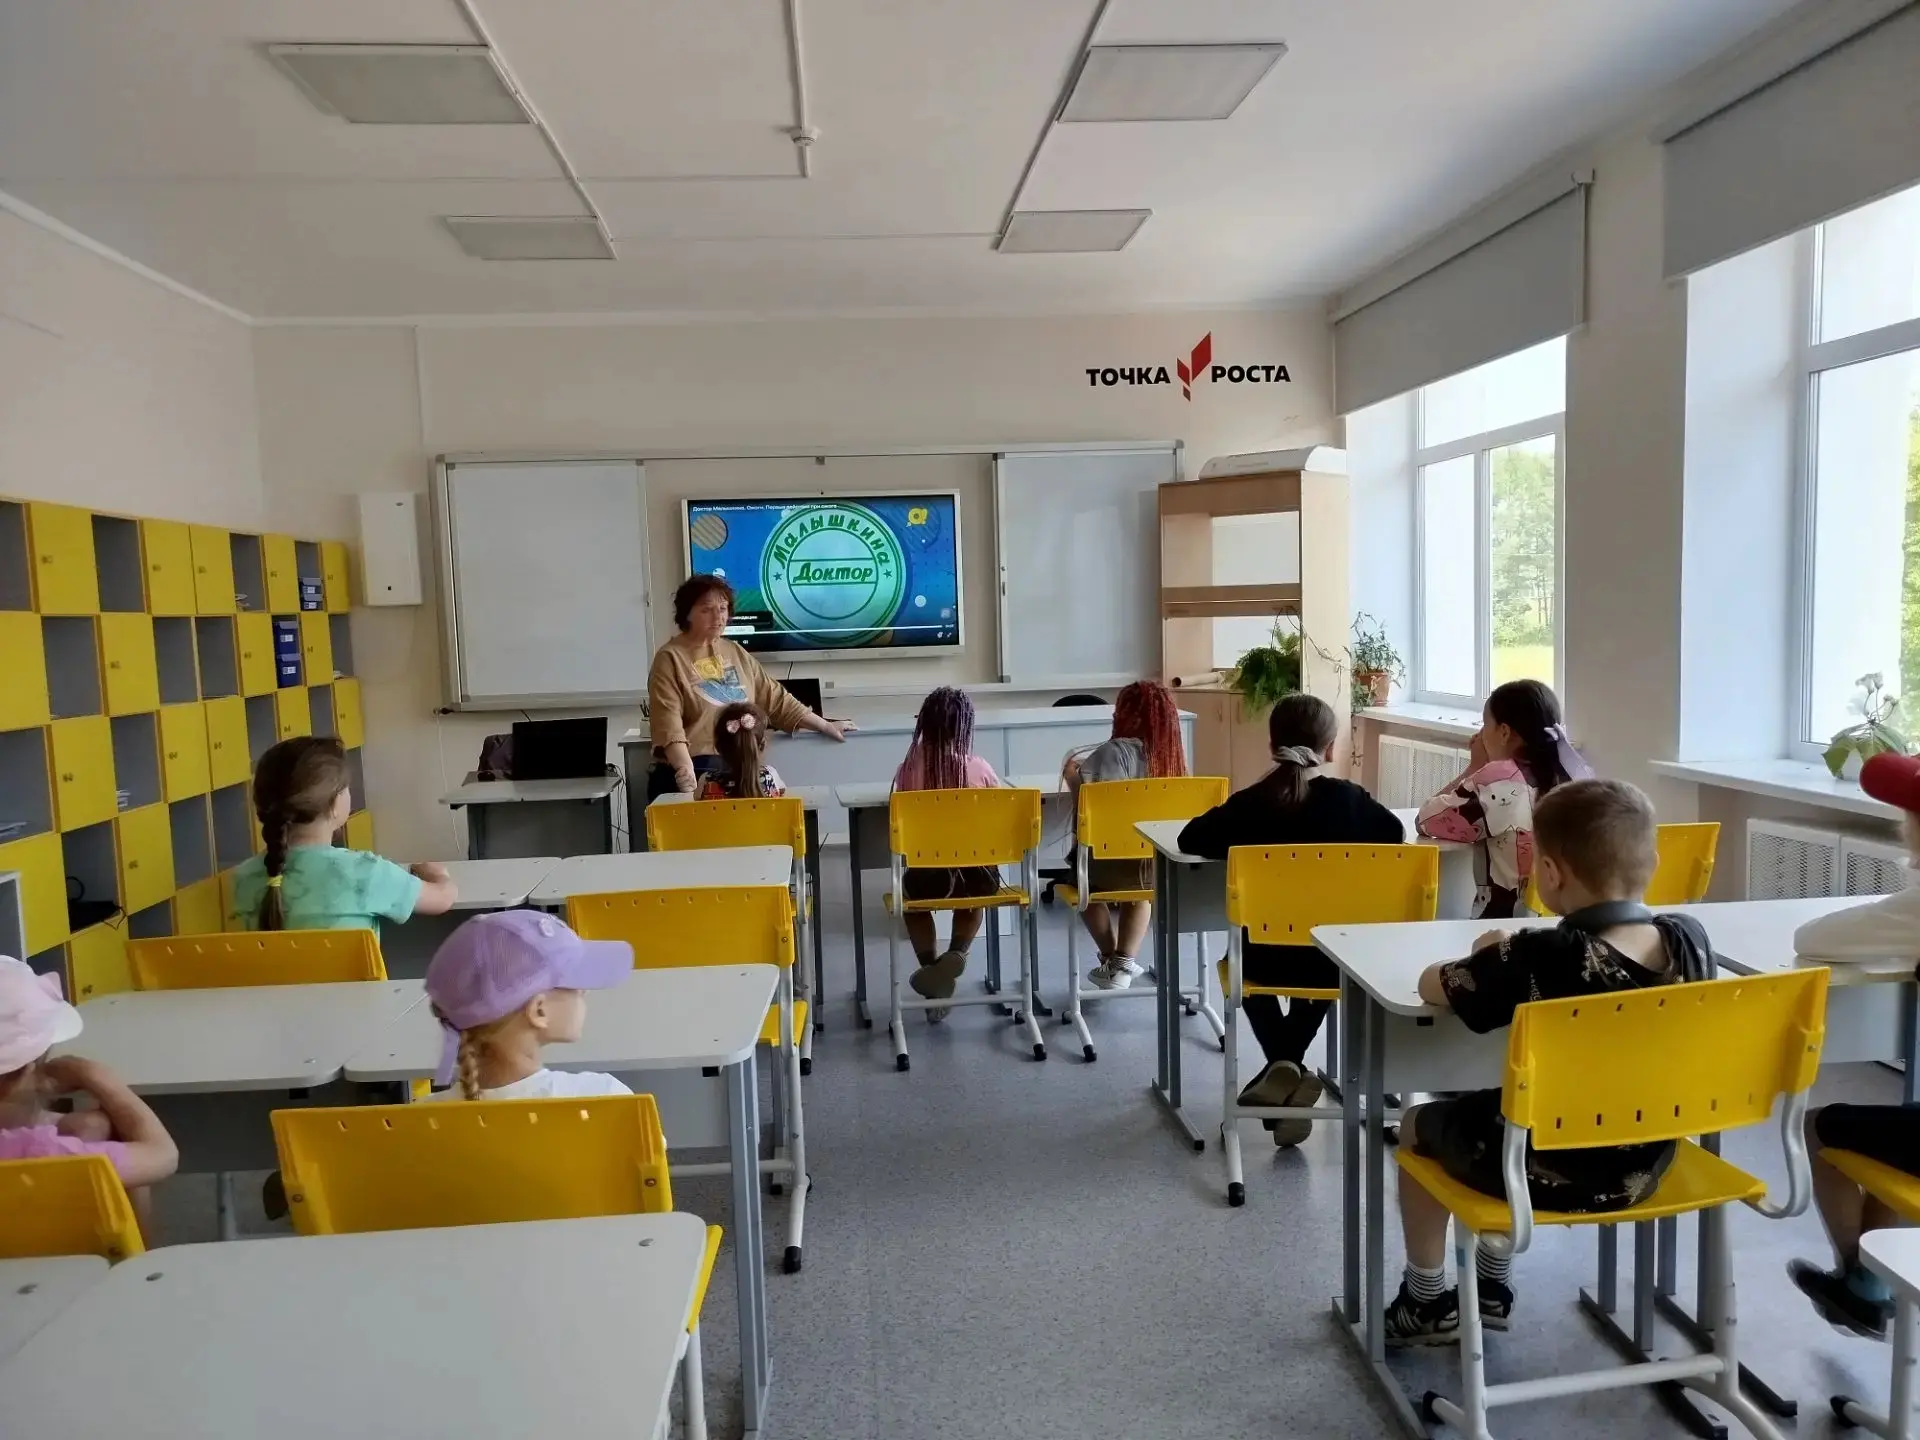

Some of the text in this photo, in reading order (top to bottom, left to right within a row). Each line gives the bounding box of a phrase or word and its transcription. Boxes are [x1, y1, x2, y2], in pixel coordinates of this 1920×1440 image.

[1086, 365, 1291, 387] ТОЧКА РОСТА
[773, 514, 890, 569] Малышкина
[793, 562, 873, 583] Доктор
